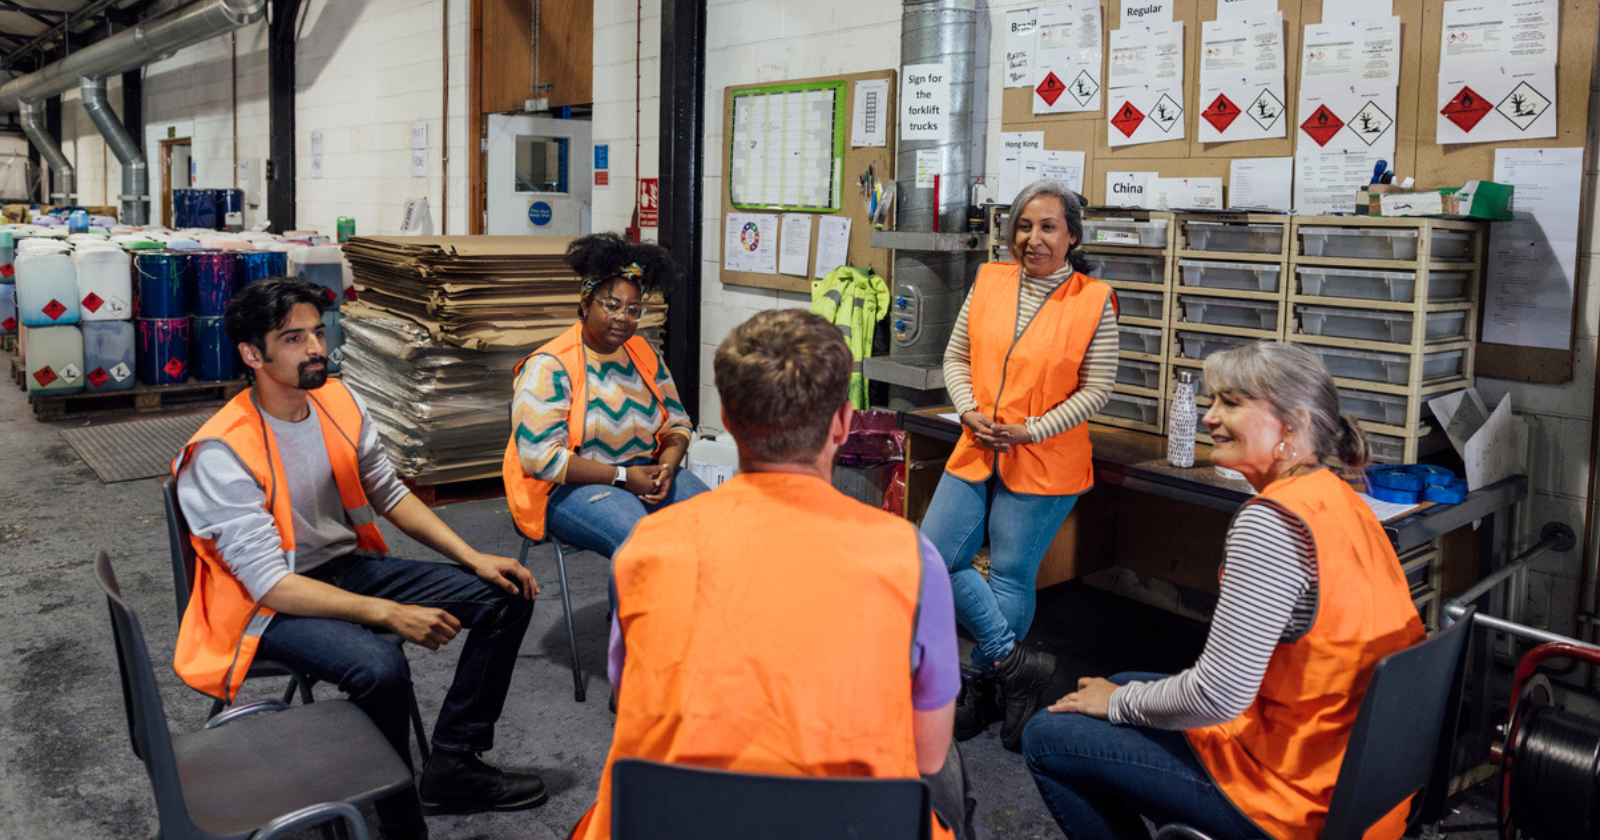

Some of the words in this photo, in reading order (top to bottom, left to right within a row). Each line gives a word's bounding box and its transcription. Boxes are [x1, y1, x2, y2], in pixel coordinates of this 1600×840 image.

[1127, 4, 1162, 17] Regular
[908, 75, 926, 85] Sign
[928, 73, 943, 83] for
[916, 90, 931, 99] the
[908, 105, 940, 115] forklift
[910, 121, 938, 131] trucks
[1005, 141, 1021, 149] Hong
[1022, 141, 1039, 149] Kong
[1112, 182, 1143, 194] China
